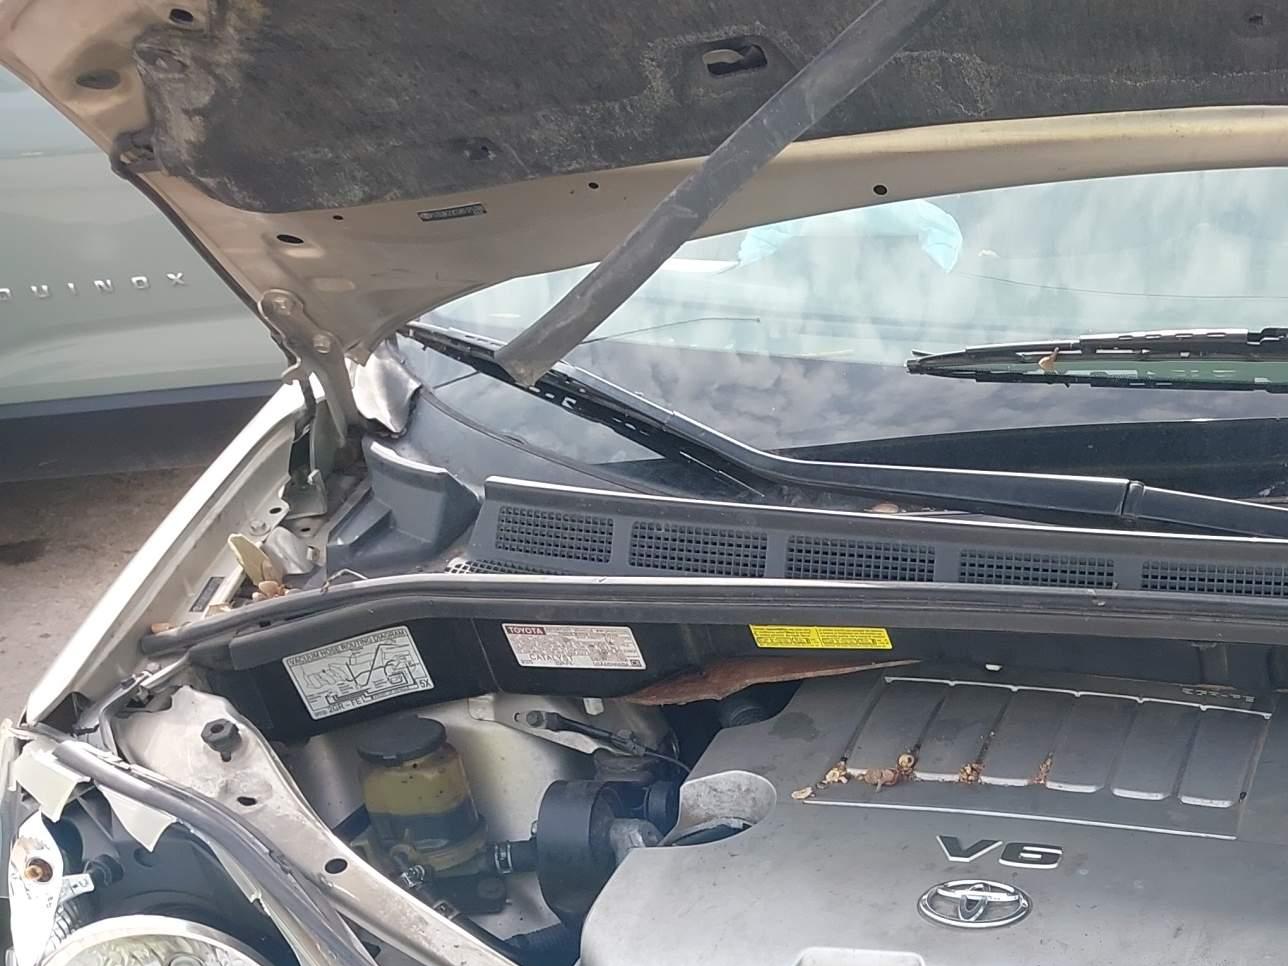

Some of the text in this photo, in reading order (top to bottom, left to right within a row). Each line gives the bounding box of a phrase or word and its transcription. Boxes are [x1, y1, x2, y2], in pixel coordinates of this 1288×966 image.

[509, 626, 544, 635] TOYOTA
[419, 679, 432, 689] 5X
[935, 835, 1064, 869] V6
